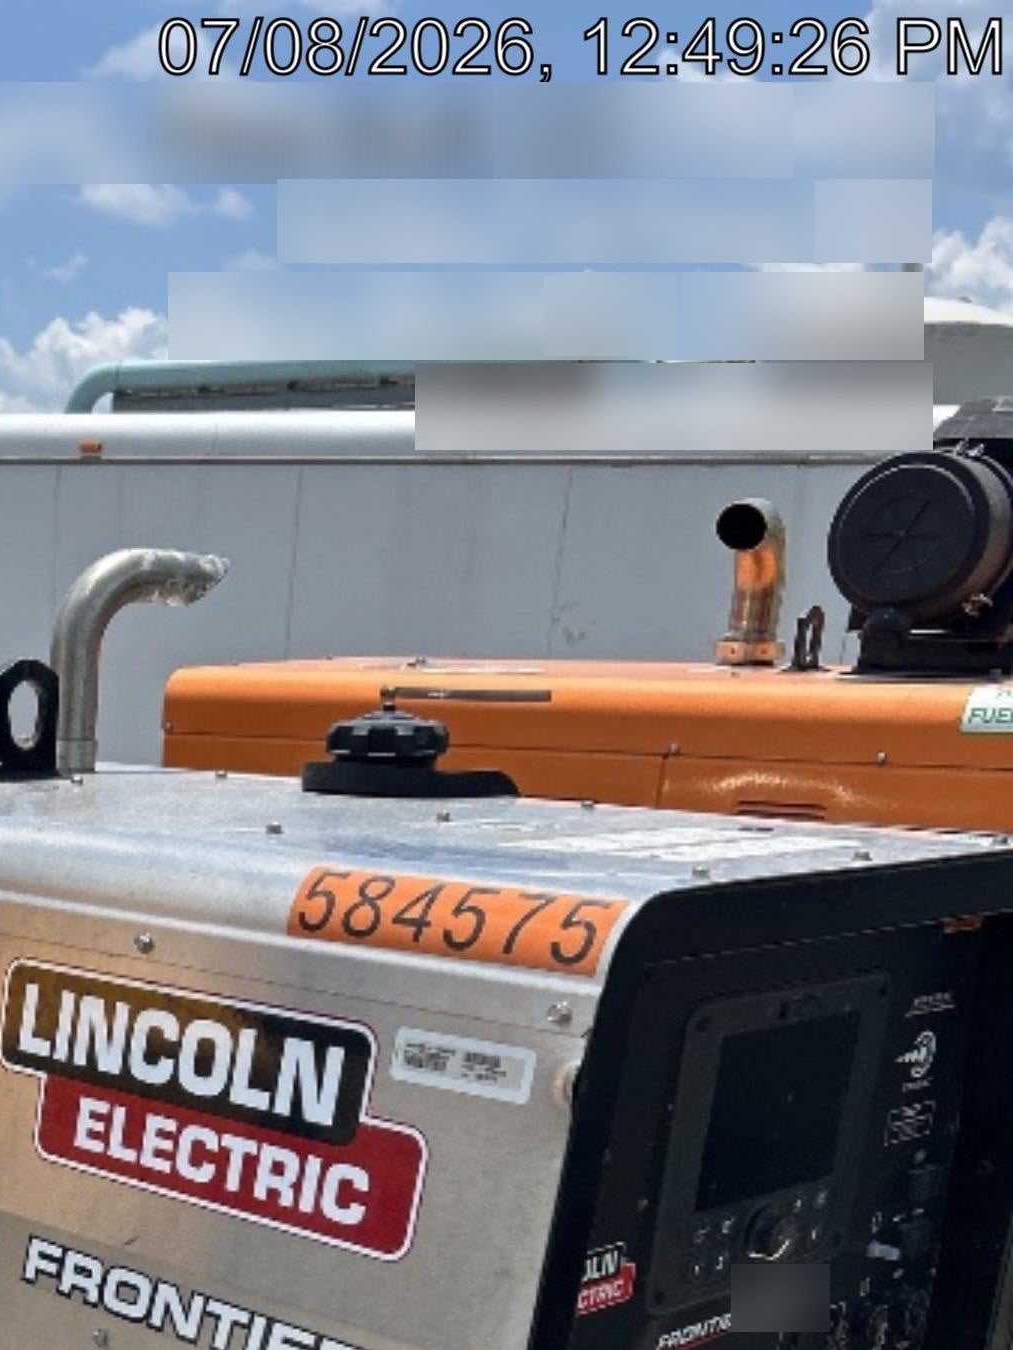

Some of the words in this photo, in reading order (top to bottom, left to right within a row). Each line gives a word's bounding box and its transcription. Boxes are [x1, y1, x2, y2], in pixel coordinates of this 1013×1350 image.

[968, 707, 1013, 724] FUE
[297, 870, 612, 965] 584575
[16, 982, 346, 1128] LINCOLN
[72, 1098, 371, 1227] ELECTRIC
